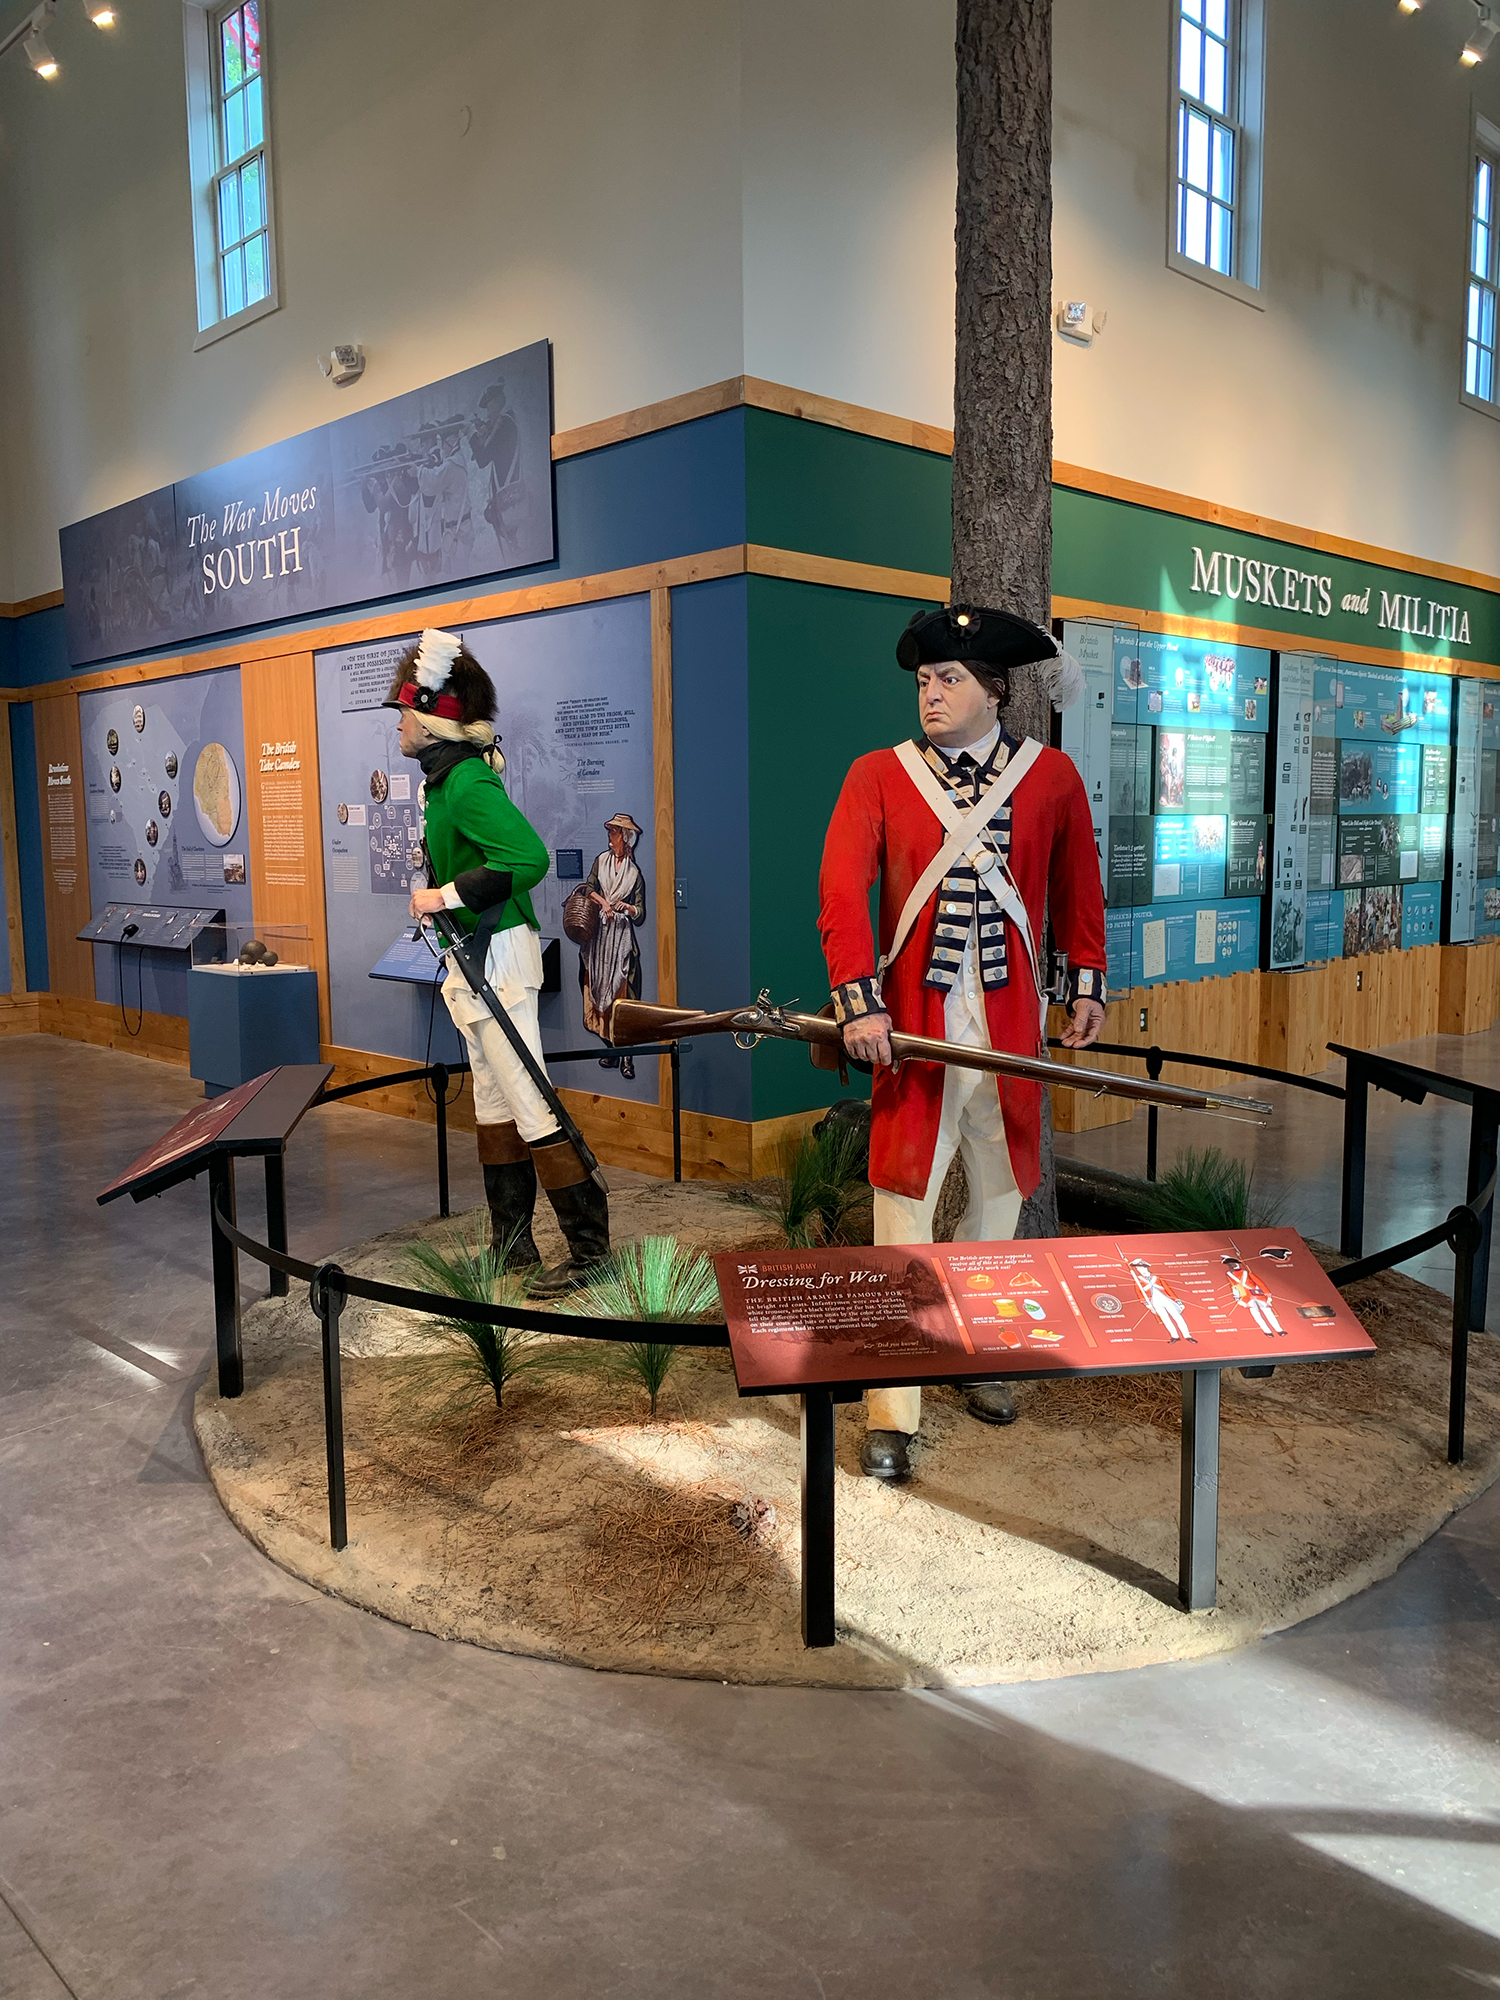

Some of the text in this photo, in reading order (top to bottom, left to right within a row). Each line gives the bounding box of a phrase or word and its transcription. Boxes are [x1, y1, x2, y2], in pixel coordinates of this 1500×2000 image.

[187, 485, 318, 548] The War Moves
[202, 526, 303, 594] SOUTH
[1190, 546, 1472, 645] MUSKETS and MILITIA
[1120, 636, 1134, 646] British
[1154, 641, 1166, 652] Upper
[262, 740, 297, 756] The British
[259, 757, 300, 772] Take Camden
[577, 759, 605, 767] The Burning
[582, 768, 600, 776] Camden
[742, 1270, 887, 1289] Dressing for War
